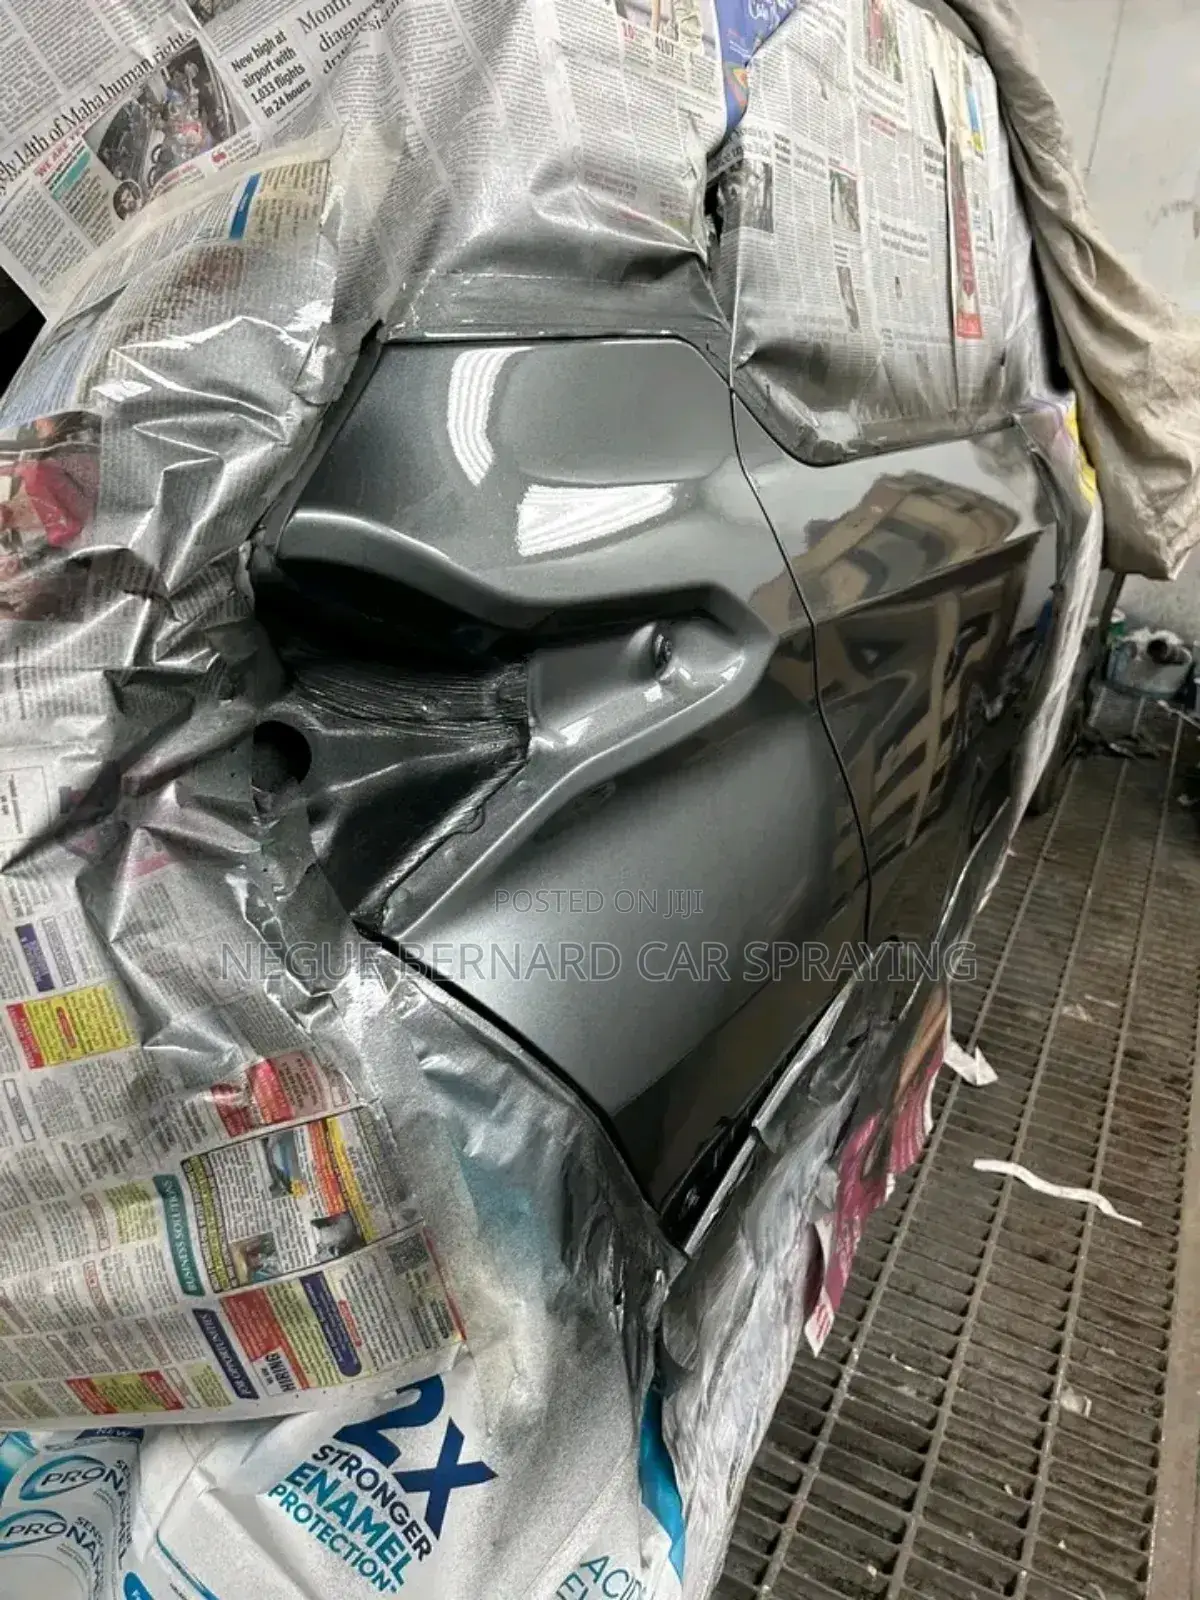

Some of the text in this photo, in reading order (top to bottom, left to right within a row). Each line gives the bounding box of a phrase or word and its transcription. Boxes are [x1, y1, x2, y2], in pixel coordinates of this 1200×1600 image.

[231, 28, 287, 73] New high at
[242, 46, 297, 89] airport with
[262, 79, 311, 118] in 24 hours
[274, 63, 306, 89] flights
[14, 135, 49, 169] 14th
[49, 118, 64, 141] of
[61, 95, 104, 132] Maha
[100, 58, 153, 100] human
[266, 1351, 296, 1393] HIRING
[333, 1374, 498, 1541] 2X
[285, 1462, 412, 1586] ENAMEL
[312, 1444, 433, 1562] STRONGER
